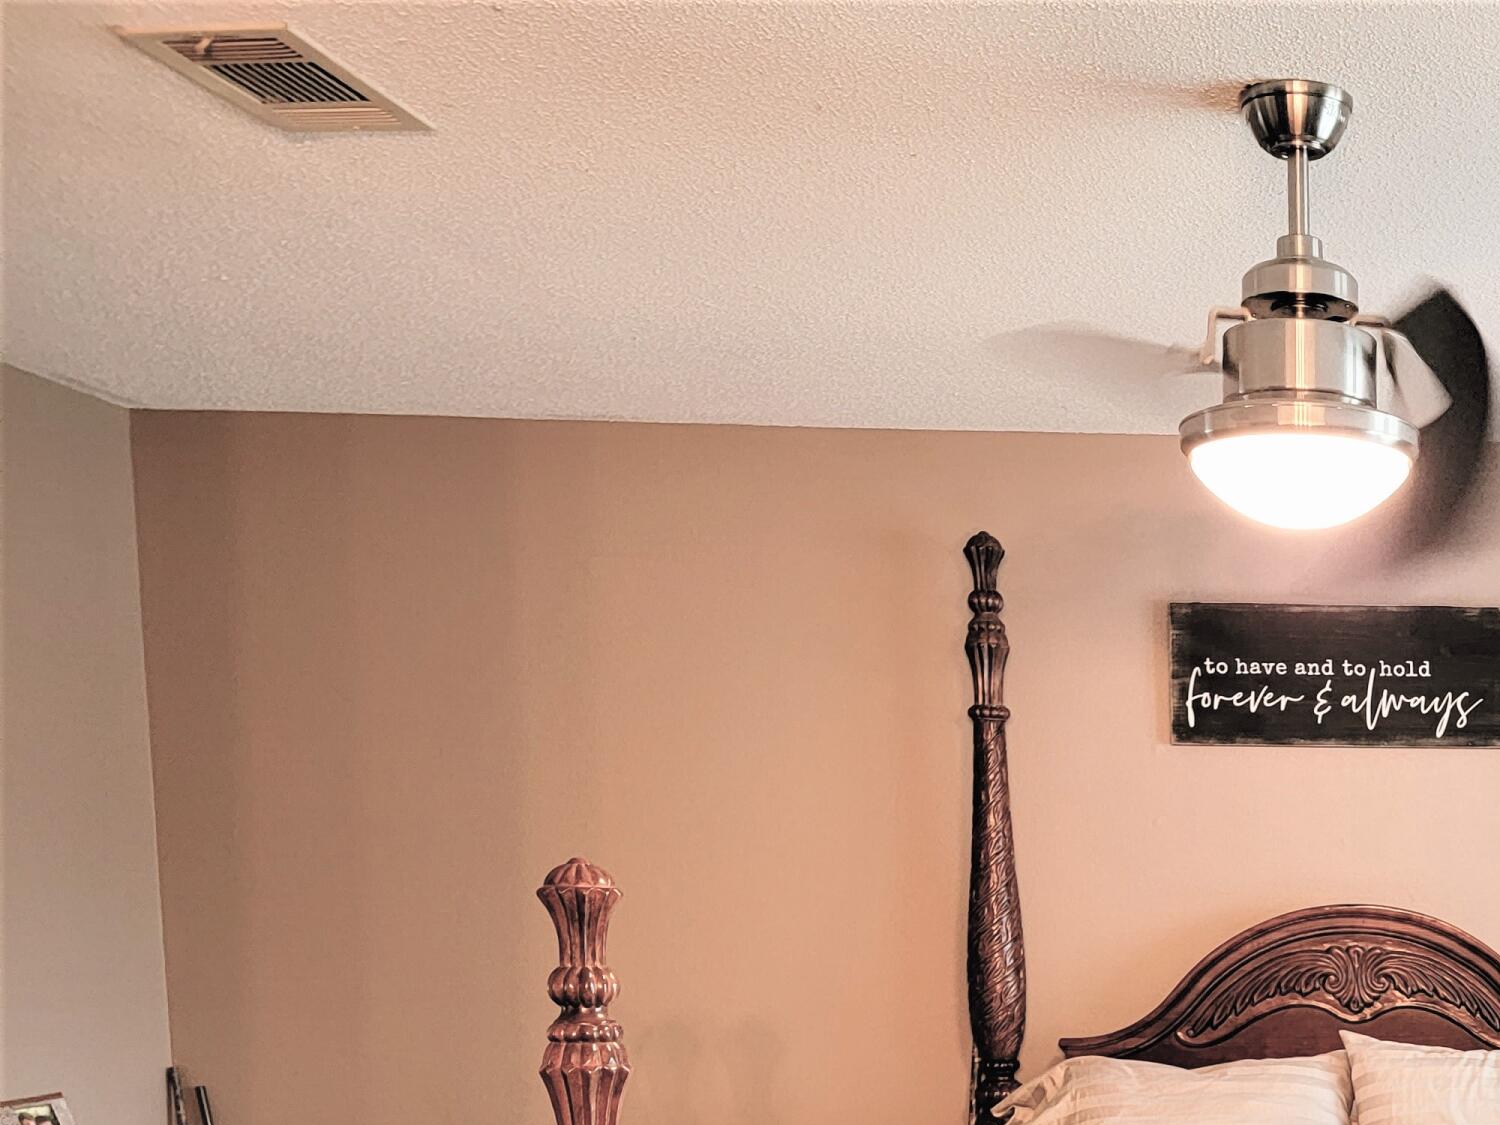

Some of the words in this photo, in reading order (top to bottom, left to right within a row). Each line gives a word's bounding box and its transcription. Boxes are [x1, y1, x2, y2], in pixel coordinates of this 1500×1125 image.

[1203, 657, 1228, 675] to
[1234, 657, 1288, 675] have
[1294, 658, 1335, 676] and
[1341, 659, 1367, 677] to
[1378, 659, 1432, 678] hold
[1185, 667, 1305, 728] forever
[1313, 679, 1333, 725] &
[1340, 667, 1484, 739] always
